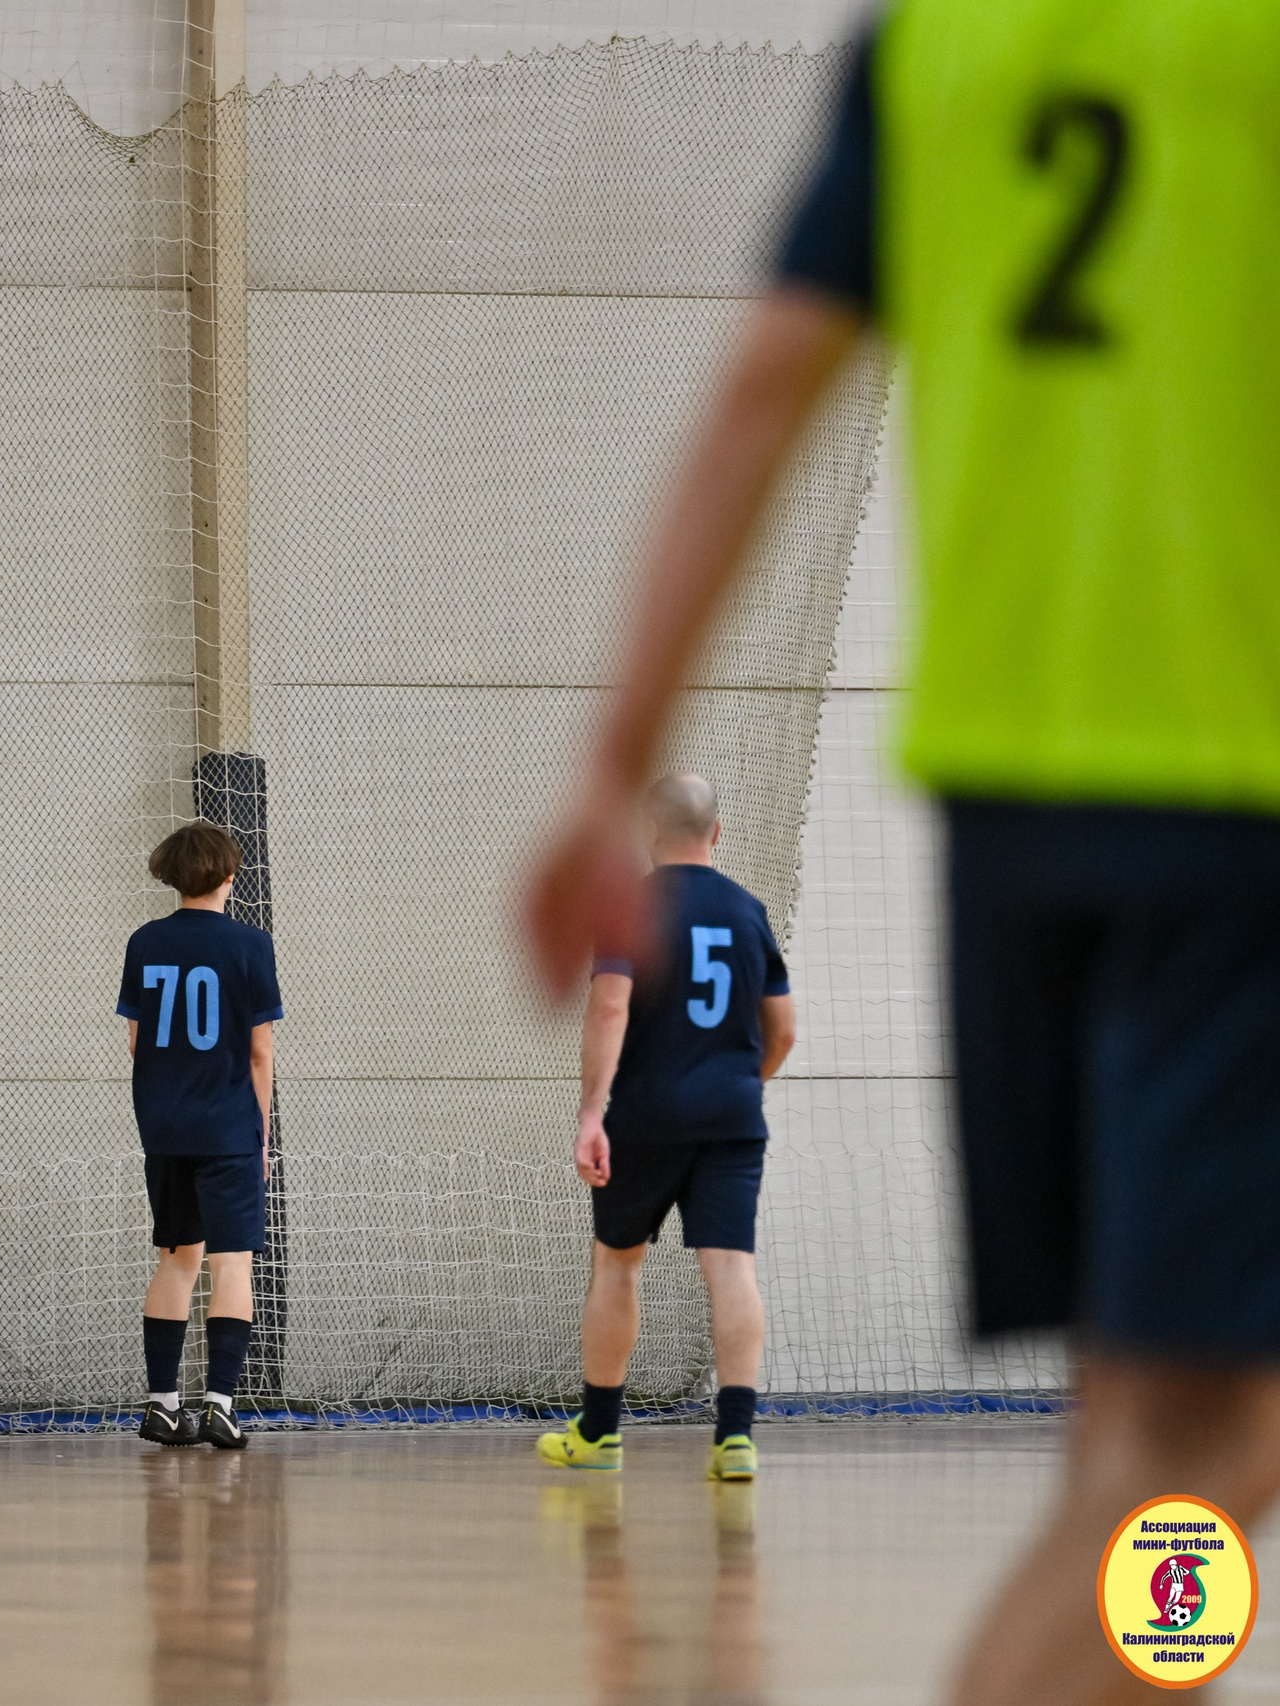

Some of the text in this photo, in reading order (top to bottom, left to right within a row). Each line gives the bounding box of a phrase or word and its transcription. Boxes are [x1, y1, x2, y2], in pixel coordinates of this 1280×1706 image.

[1013, 88, 1132, 352] 2
[142, 964, 221, 1051] 70
[686, 925, 733, 1029] 5
